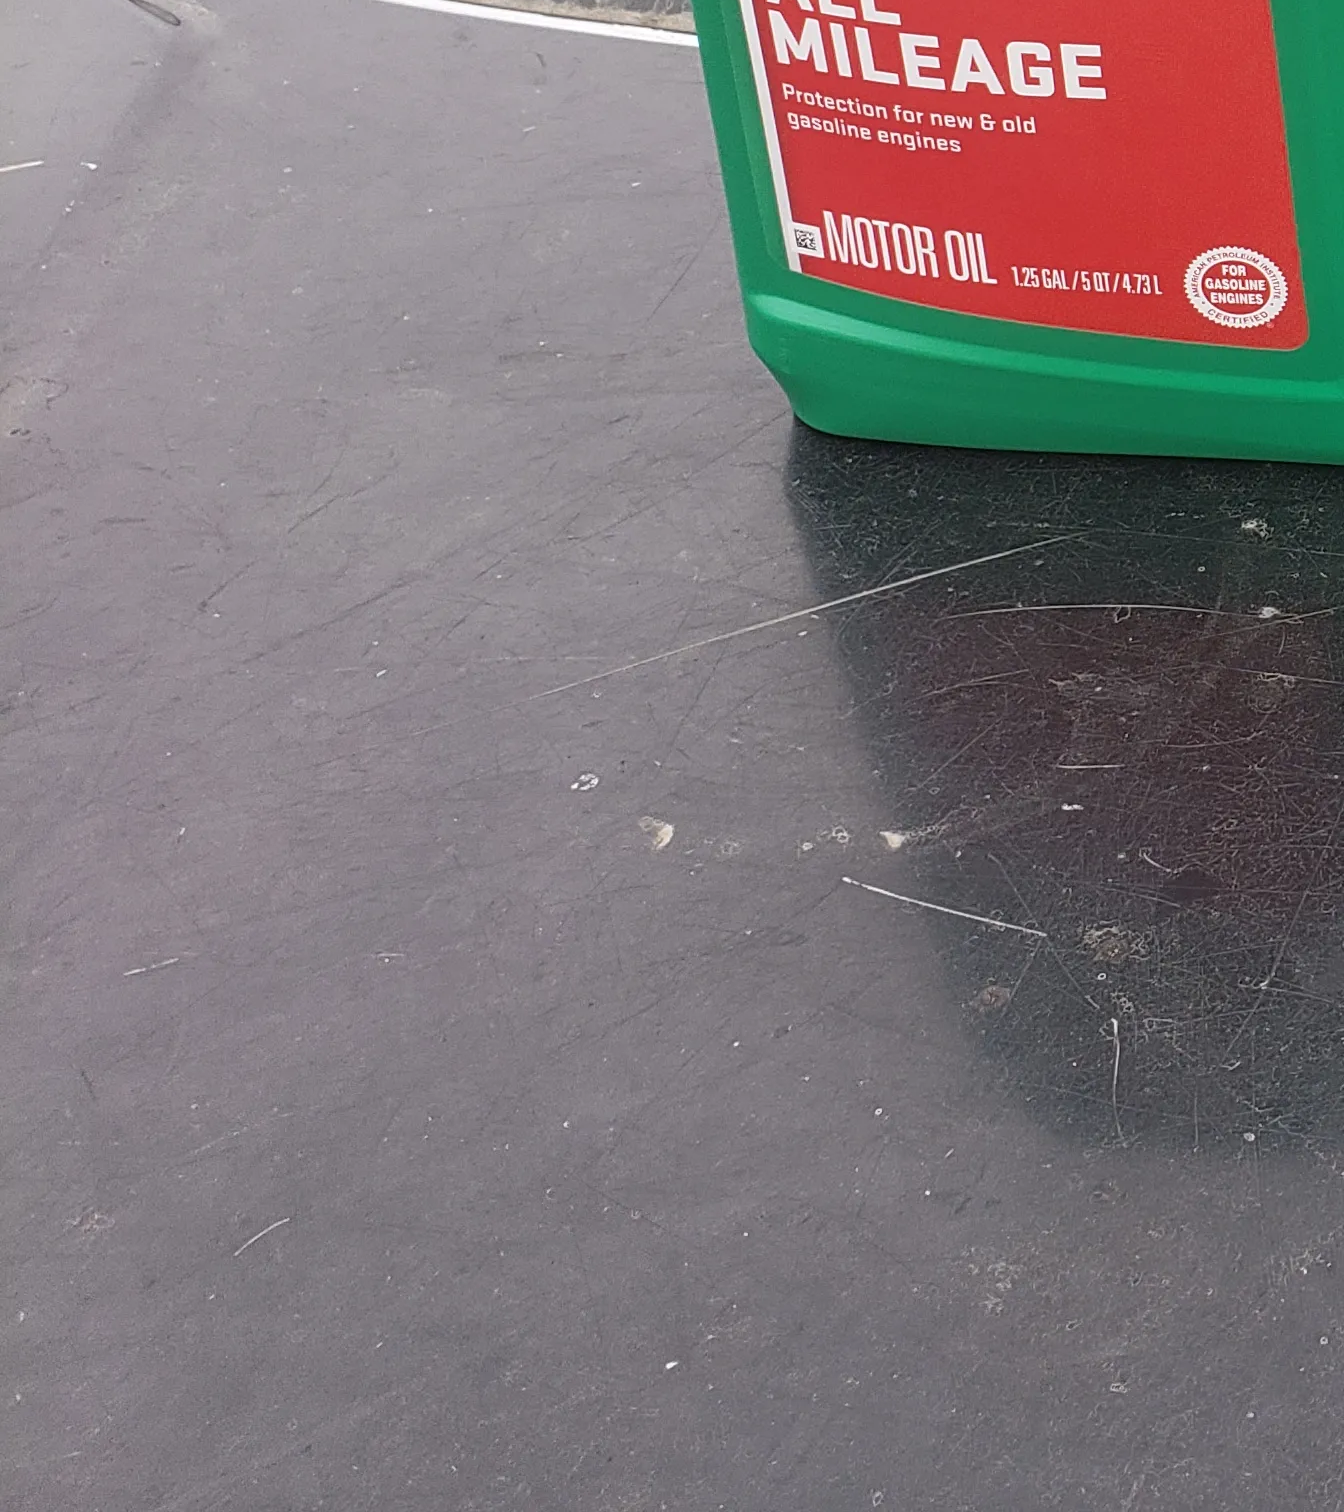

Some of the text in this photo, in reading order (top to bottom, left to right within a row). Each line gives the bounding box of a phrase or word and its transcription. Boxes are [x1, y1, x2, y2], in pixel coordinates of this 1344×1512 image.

[767, 8, 1107, 100] MILEAGE
[781, 82, 1037, 134] Protection for new & old
[787, 110, 962, 153] gasoline engines
[821, 209, 998, 285] MOTOR OIL
[1011, 265, 1163, 295] 1.25 GAL / 5 QT / 4.73 L
[1190, 252, 1282, 300] AMERICAN PETROLEUM INSTITUTE
[1205, 277, 1267, 291] GASOLINE
[1221, 264, 1247, 277] FOR
[1207, 308, 1269, 324] CERTIFIED
[1210, 292, 1264, 305] ENGINES
